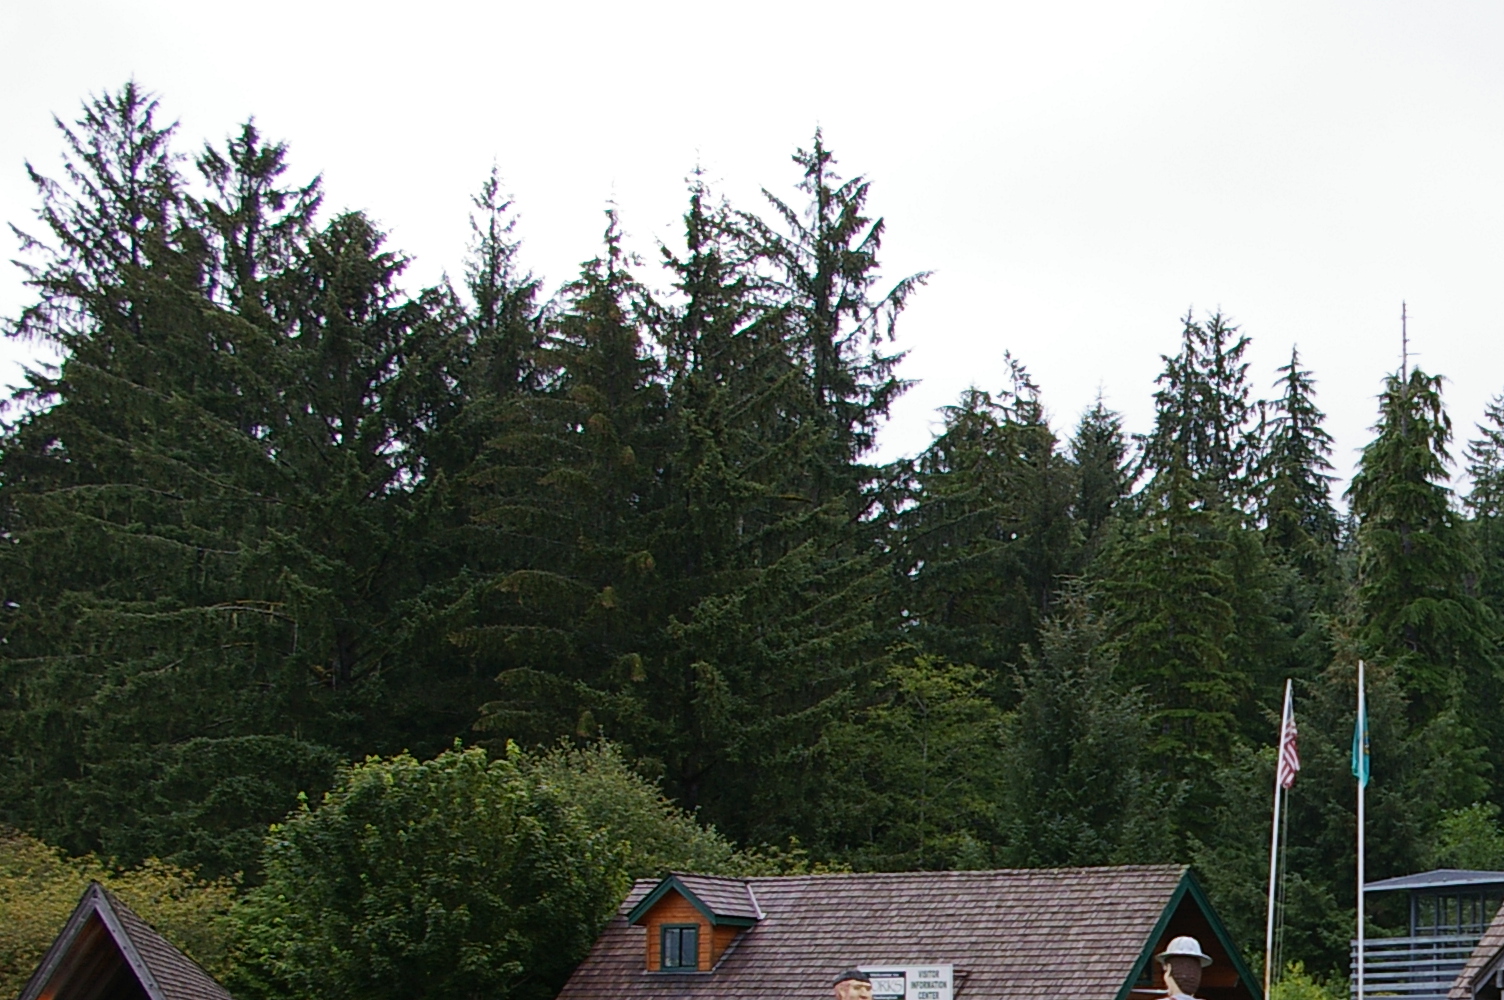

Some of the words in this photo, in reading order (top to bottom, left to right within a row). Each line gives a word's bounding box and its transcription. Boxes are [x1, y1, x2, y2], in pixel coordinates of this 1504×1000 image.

[918, 970, 940, 978] VISITOR
[872, 979, 903, 993] ORKS
[910, 981, 947, 989] INFORMATION
[918, 991, 940, 1000] CENTER
